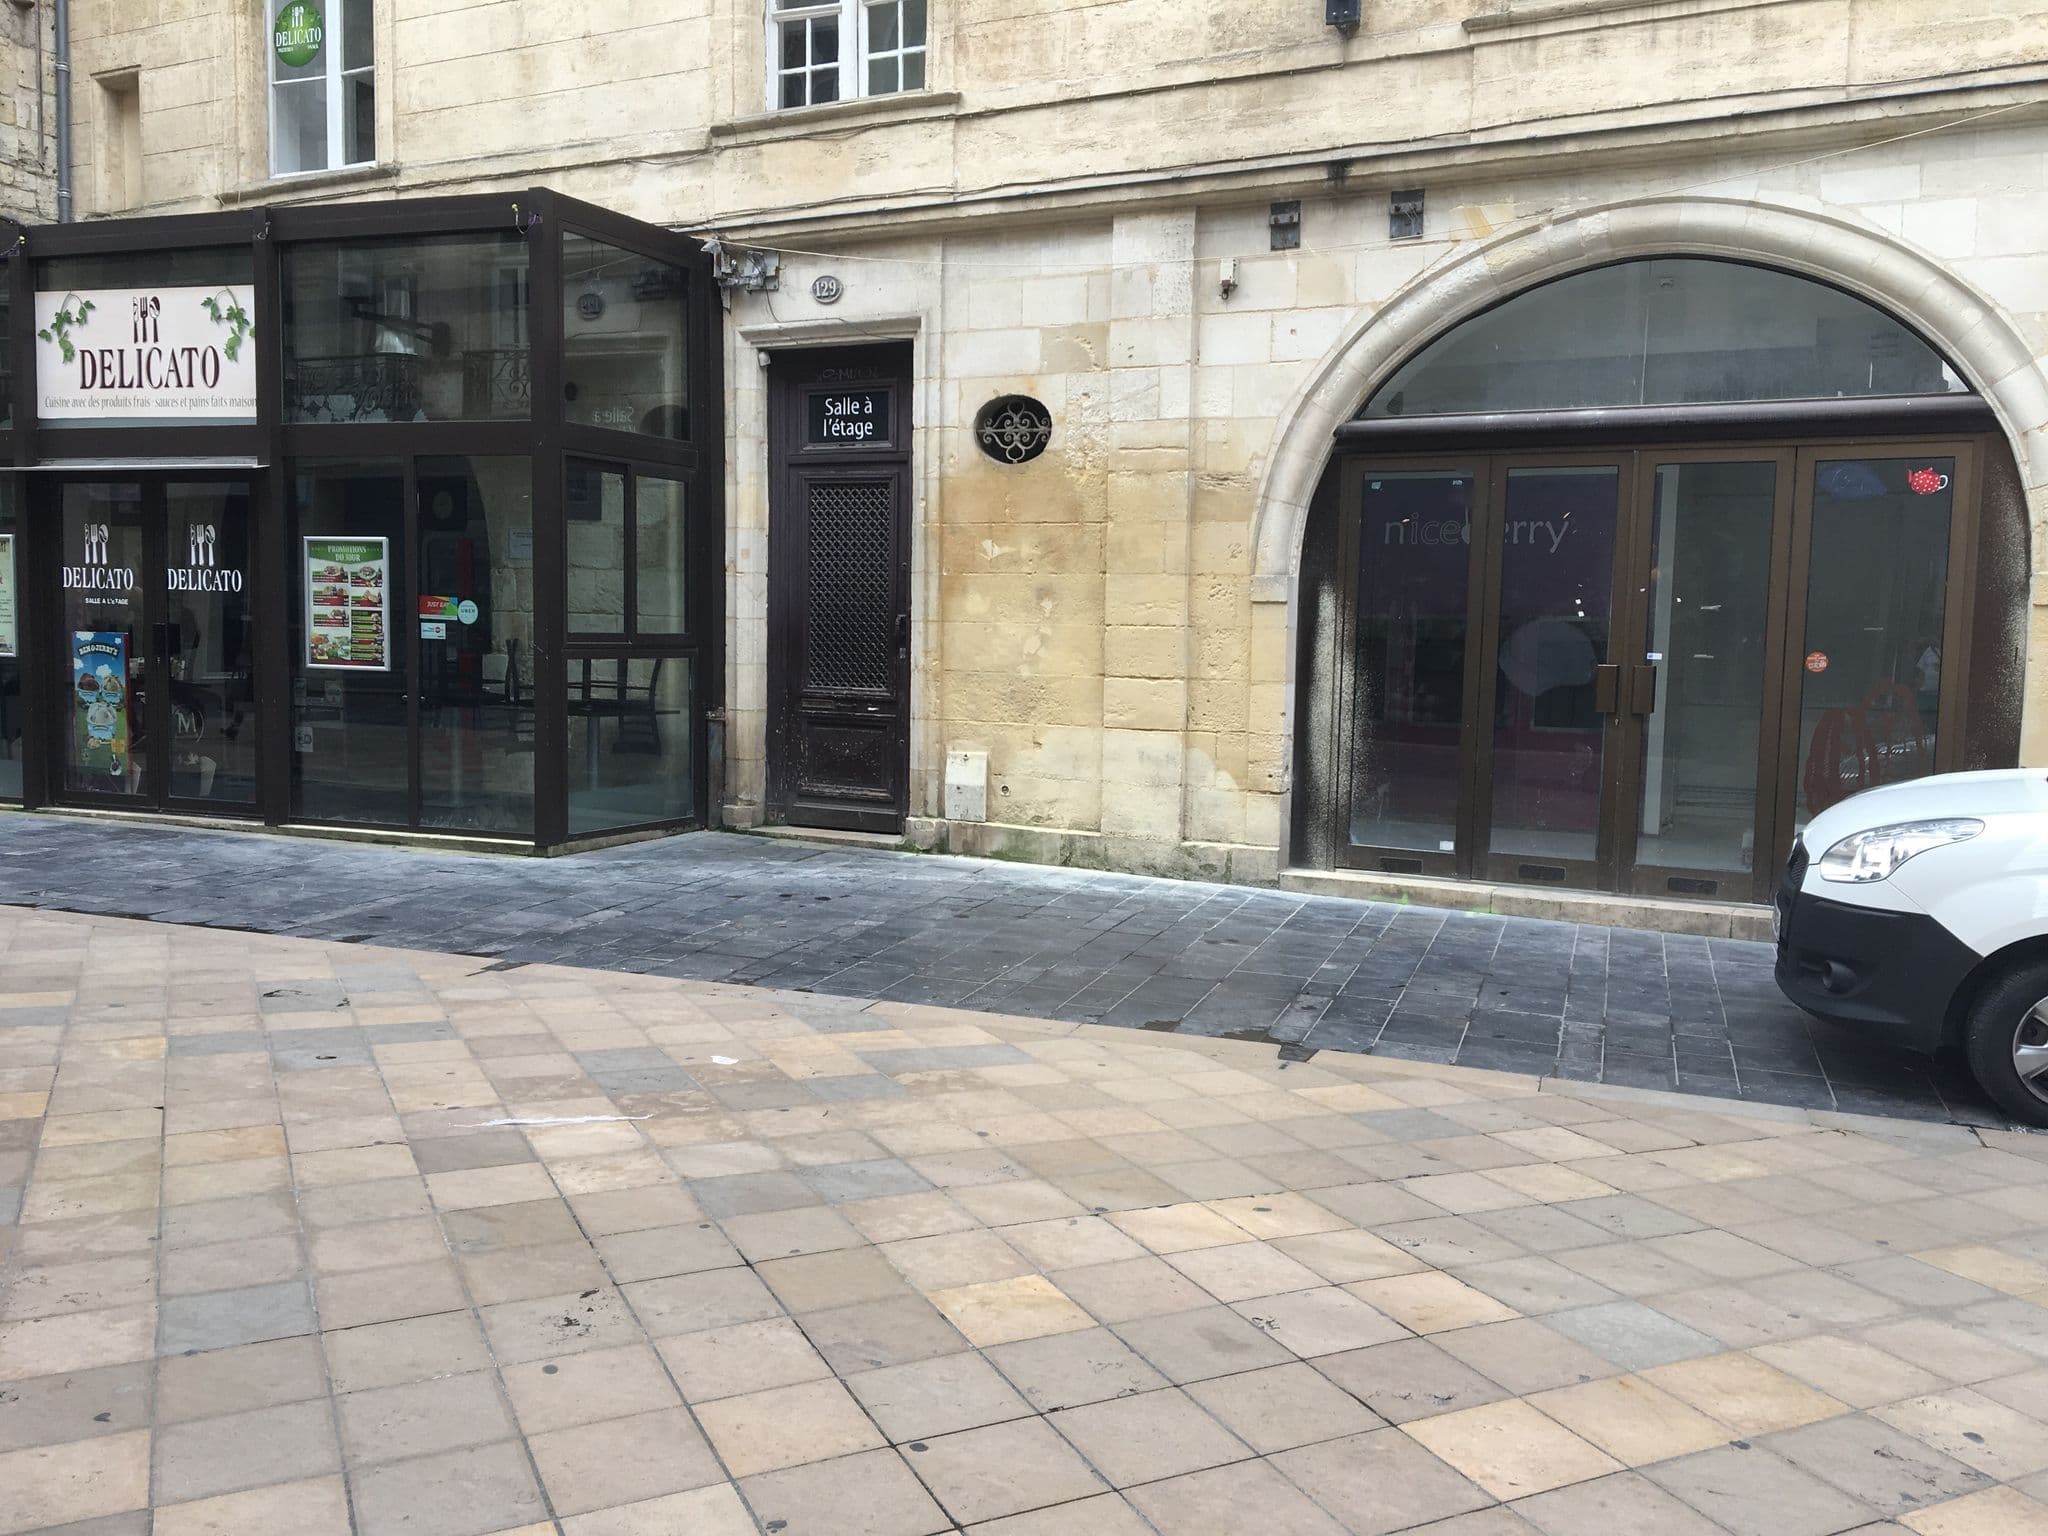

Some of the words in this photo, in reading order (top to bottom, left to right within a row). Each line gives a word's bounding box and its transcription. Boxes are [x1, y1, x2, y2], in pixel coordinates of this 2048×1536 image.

[276, 26, 322, 47] DELICATO
[815, 280, 836, 298] 129
[79, 345, 221, 390] DELICATO
[71, 398, 87, 408] avec
[88, 396, 100, 408] des
[100, 395, 133, 410] produits
[133, 395, 151, 408] frais
[189, 396, 210, 410] pains
[211, 395, 228, 408] faits
[824, 397, 860, 416] Salle
[863, 396, 873, 415] à
[823, 419, 873, 440] l'étage
[62, 567, 134, 590] DELICATO
[167, 569, 243, 592] DELICATO
